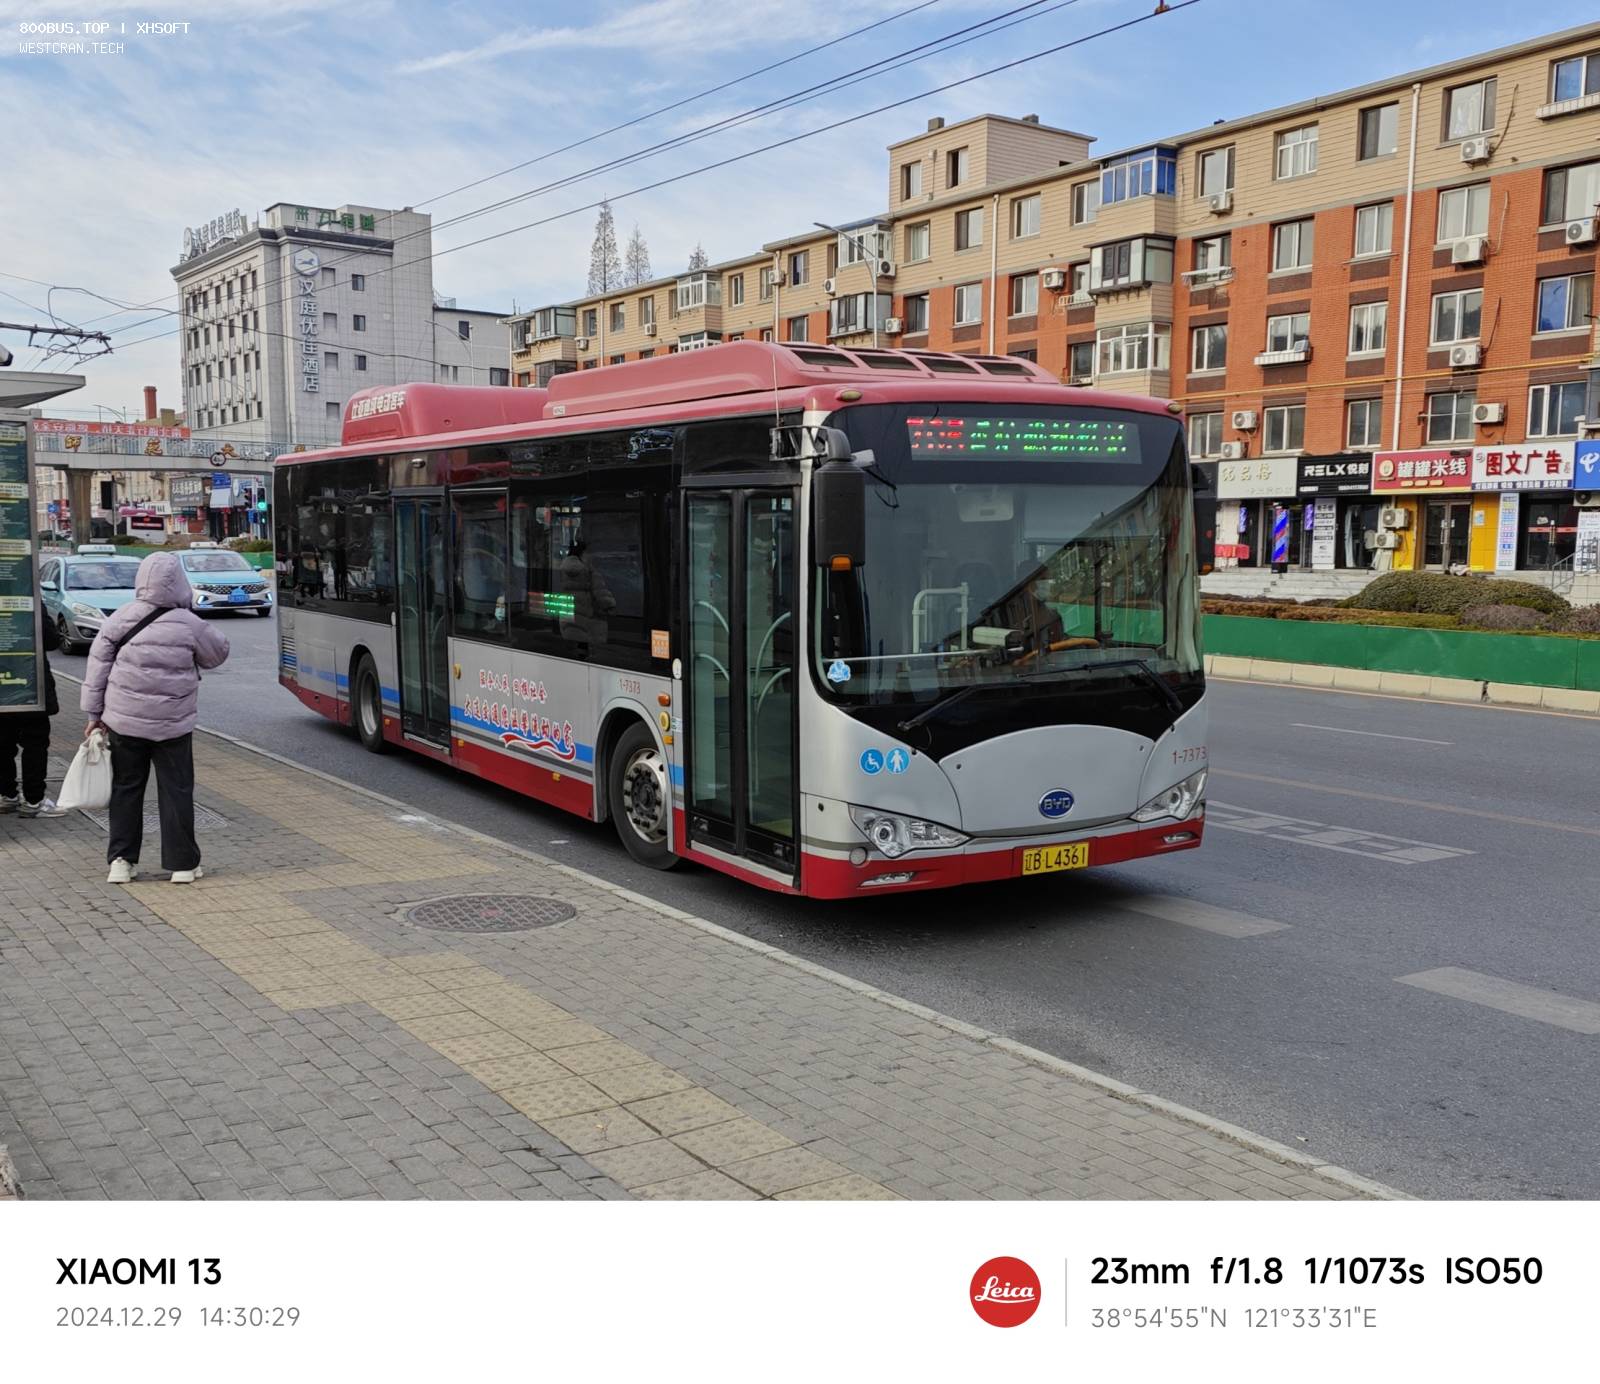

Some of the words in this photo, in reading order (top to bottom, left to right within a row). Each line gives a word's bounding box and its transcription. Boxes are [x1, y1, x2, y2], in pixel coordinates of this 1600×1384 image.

[300, 279, 319, 392] 汉庭优佳酒店
[1304, 464, 1346, 477] RELX
[1347, 462, 1370, 475] 悦刻
[1397, 457, 1467, 478] 罐罐米线
[1485, 450, 1562, 476] 图文广告
[619, 678, 641, 695] 1-7373
[1171, 746, 1208, 765] 1-7373
[1042, 796, 1071, 812] BYD
